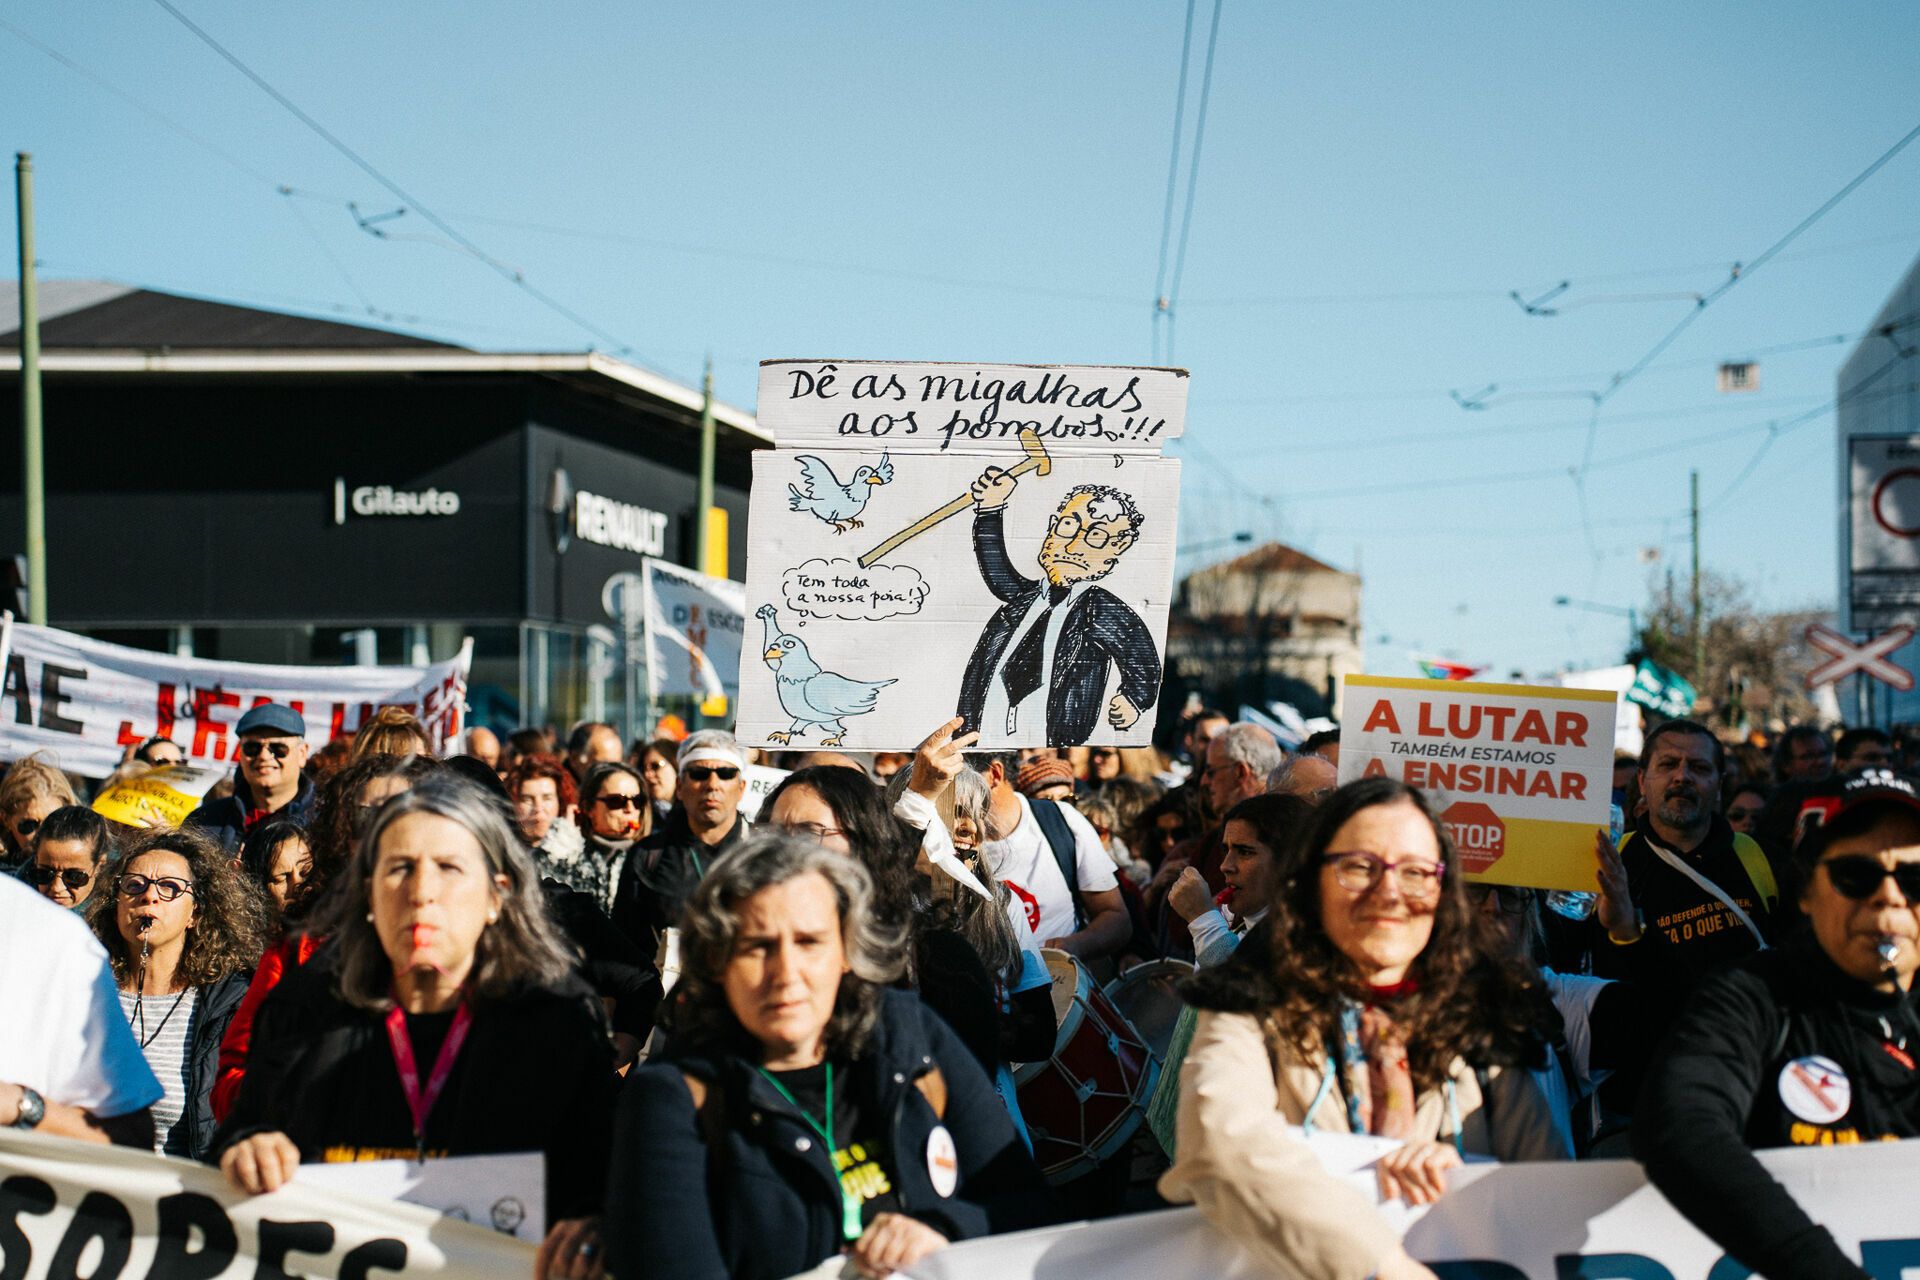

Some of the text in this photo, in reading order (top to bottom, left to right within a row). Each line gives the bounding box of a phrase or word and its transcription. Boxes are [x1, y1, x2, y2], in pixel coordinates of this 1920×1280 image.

[788, 365, 1143, 424] Dê as migalhas
[838, 410, 919, 436] aos
[351, 486, 461, 516] Gilauto
[575, 490, 669, 557] RENAULT
[797, 574, 871, 589] Tem toda
[797, 592, 810, 604] a
[814, 593, 866, 603] nossa
[1362, 698, 1589, 748] A LUTAR
[1390, 741, 1556, 765] TAMBÉM ESTAMOS
[1361, 758, 1588, 801] A ENSINAR
[1696, 914, 1724, 937] QUE
